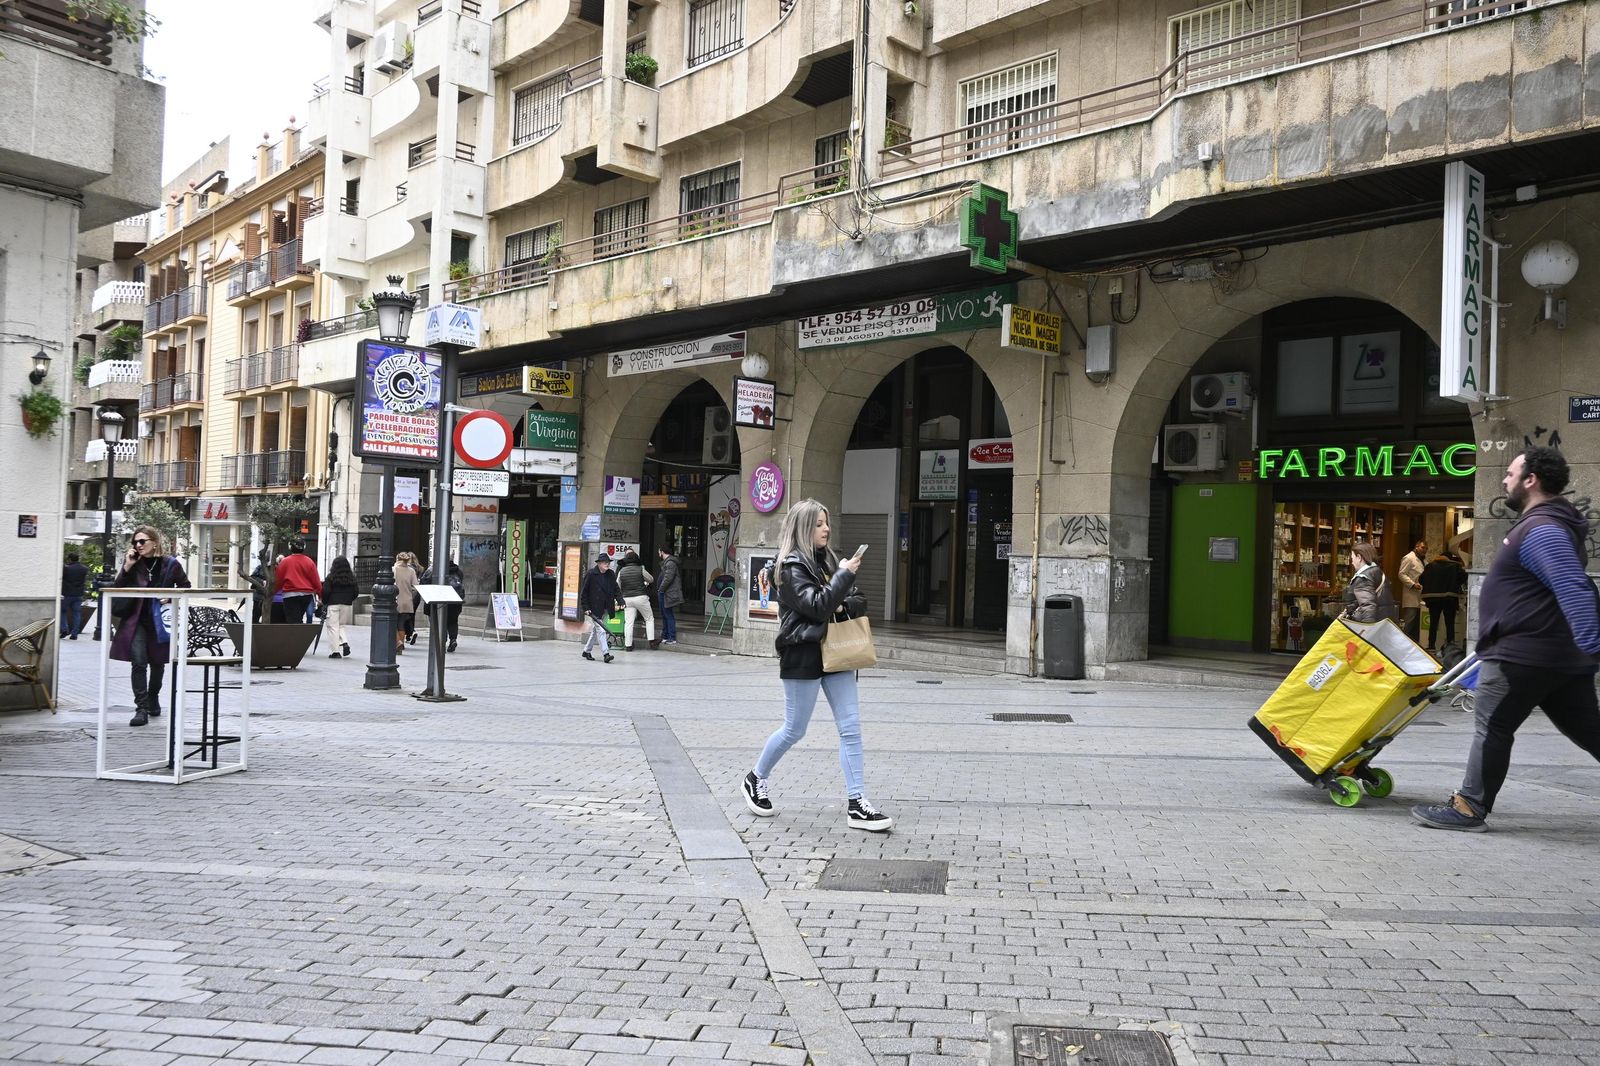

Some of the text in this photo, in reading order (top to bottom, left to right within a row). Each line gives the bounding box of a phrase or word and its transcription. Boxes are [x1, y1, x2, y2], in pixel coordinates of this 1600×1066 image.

[1462, 174, 1481, 392] FARMACIA
[800, 299, 937, 330] TLF: 954 57 09 09
[1012, 306, 1060, 329] PEDRO MORALES
[803, 330, 818, 339] SE
[820, 324, 861, 337] VENDE
[864, 320, 894, 330] PISO
[847, 331, 884, 341] AGOSTO
[1013, 320, 1057, 342] NUEVA IMAGEN
[629, 342, 700, 362] CONSTRUCCION
[629, 359, 664, 371] Y VENTA
[737, 389, 773, 400] HELADERÍA
[369, 412, 399, 423] PARQUE
[411, 417, 436, 427] BOLAS
[375, 422, 435, 435] CELEBRACIONES
[367, 432, 395, 441] EVENTOS
[400, 436, 436, 446] DESAYUNOS
[529, 421, 577, 443] Virginia
[363, 442, 388, 453] CALLE
[992, 444, 1014, 455] Crea
[1259, 443, 1477, 479] FARMAC
[755, 466, 775, 484] Taco
[1313, 663, 1333, 683] 7906
